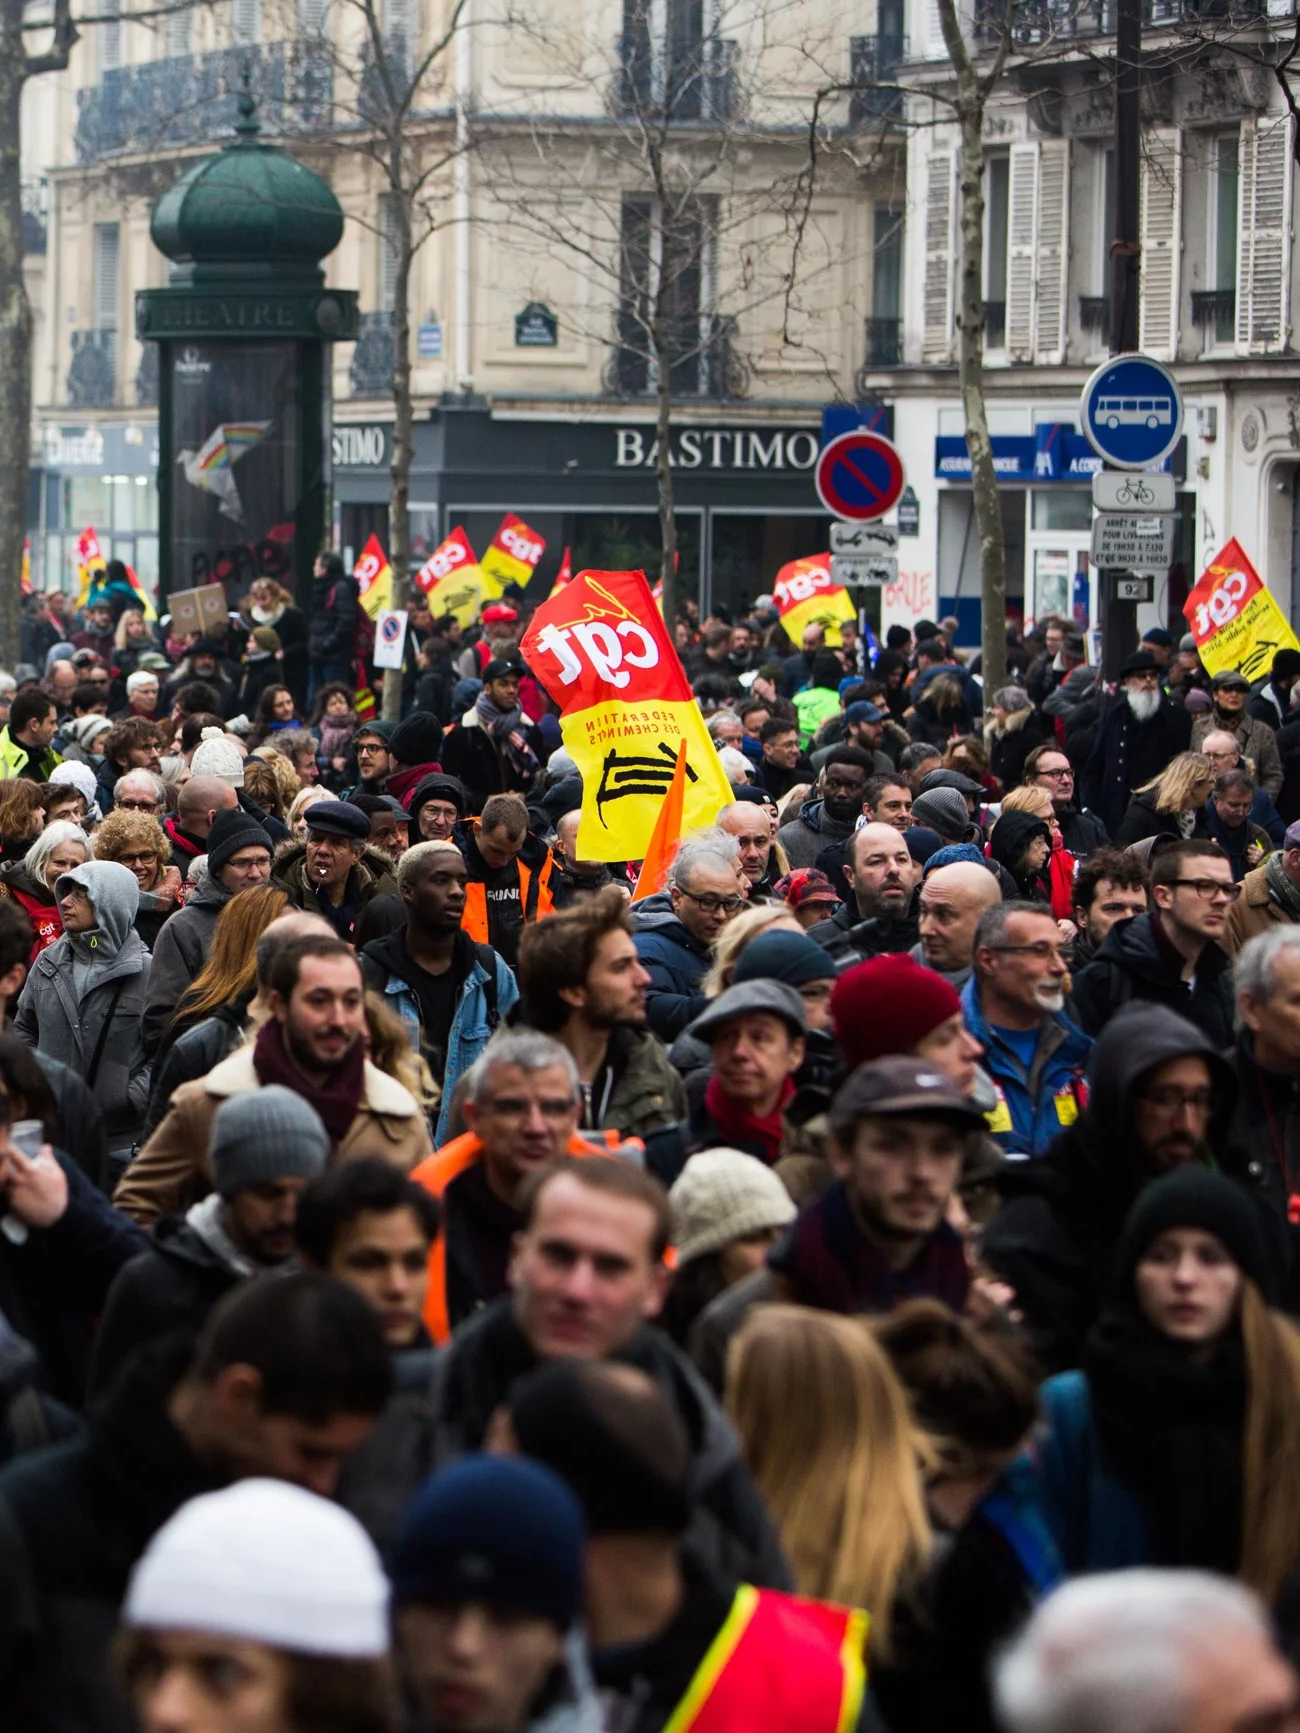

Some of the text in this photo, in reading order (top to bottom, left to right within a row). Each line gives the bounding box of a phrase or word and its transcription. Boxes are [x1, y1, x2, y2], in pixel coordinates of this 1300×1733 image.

[615, 428, 819, 469] BASTIMO
[1102, 530, 1120, 540] POUR
[501, 528, 545, 565] cgt
[1101, 543, 1111, 552] DE
[39, 922, 56, 936] cgt
